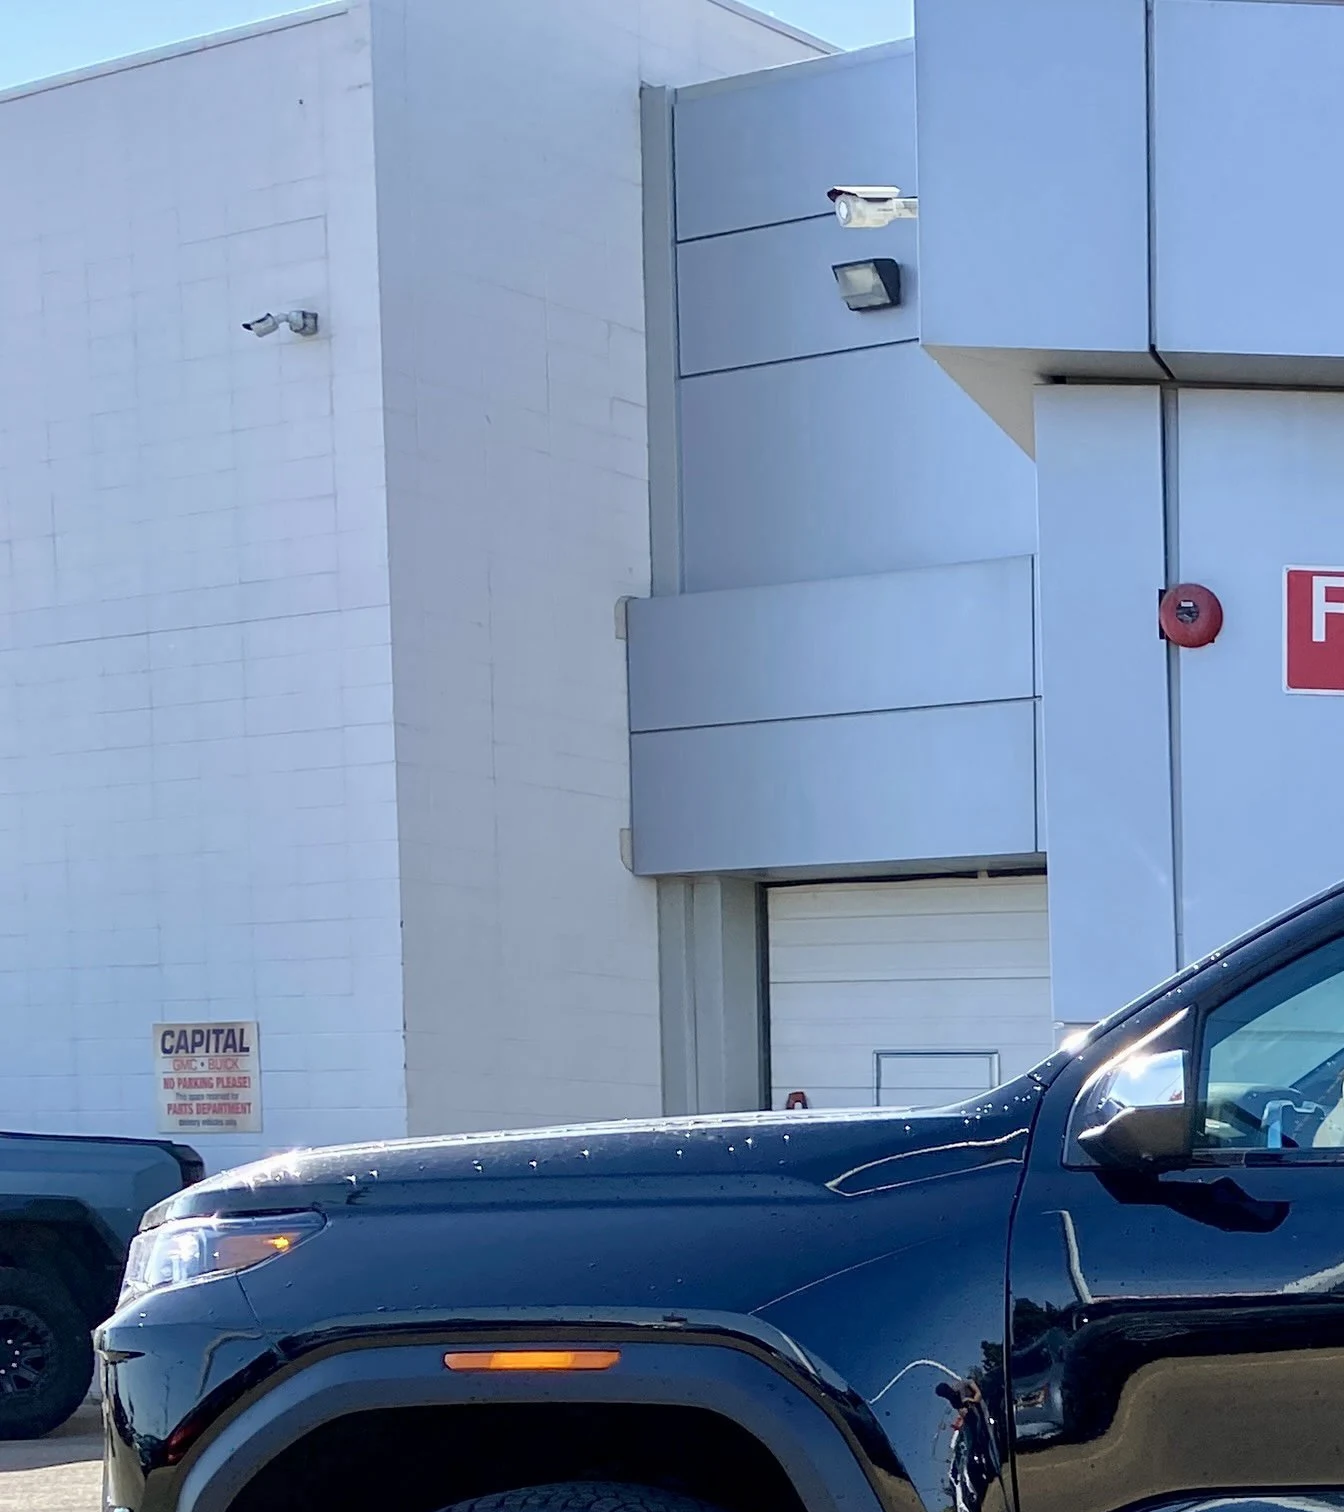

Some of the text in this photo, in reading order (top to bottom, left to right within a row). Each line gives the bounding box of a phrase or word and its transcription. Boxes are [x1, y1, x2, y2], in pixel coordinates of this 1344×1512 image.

[161, 1028, 250, 1054] CAPITAL
[173, 1058, 240, 1071] GMC BUICK
[163, 1077, 175, 1090] NO
[177, 1077, 214, 1089] PARKING
[167, 1102, 252, 1115] PARTS DEPARTMENT
